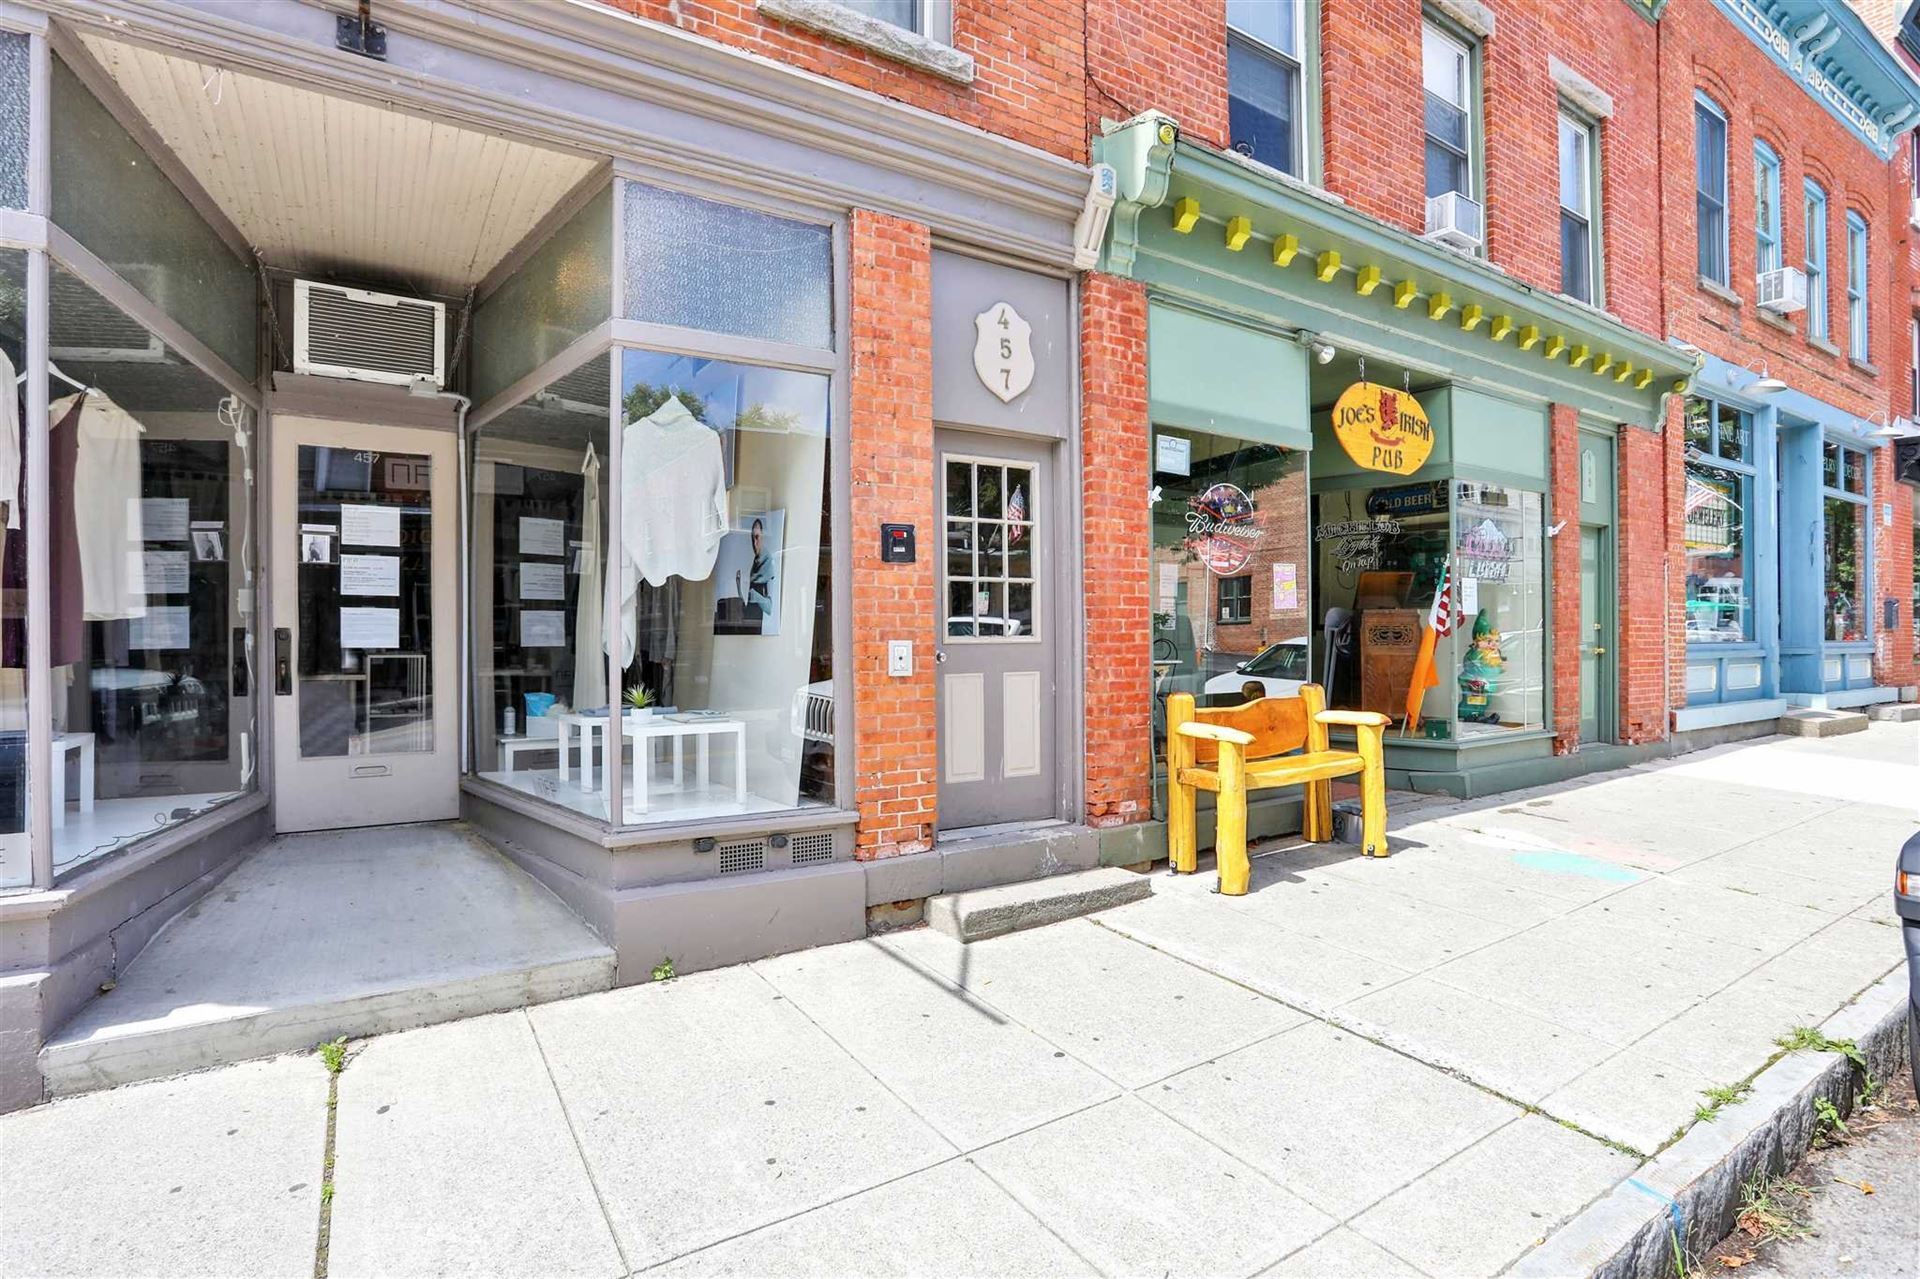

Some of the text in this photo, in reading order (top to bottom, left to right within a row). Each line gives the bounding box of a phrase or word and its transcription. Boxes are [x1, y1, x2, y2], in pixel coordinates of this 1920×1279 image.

[997, 308, 1012, 391] 457
[1337, 403, 1431, 442] JOE'S IRISH
[353, 452, 381, 464] 457
[1371, 446, 1404, 470] PUB
[1404, 493, 1431, 507] BEER
[1185, 511, 1264, 539] Budweiser
